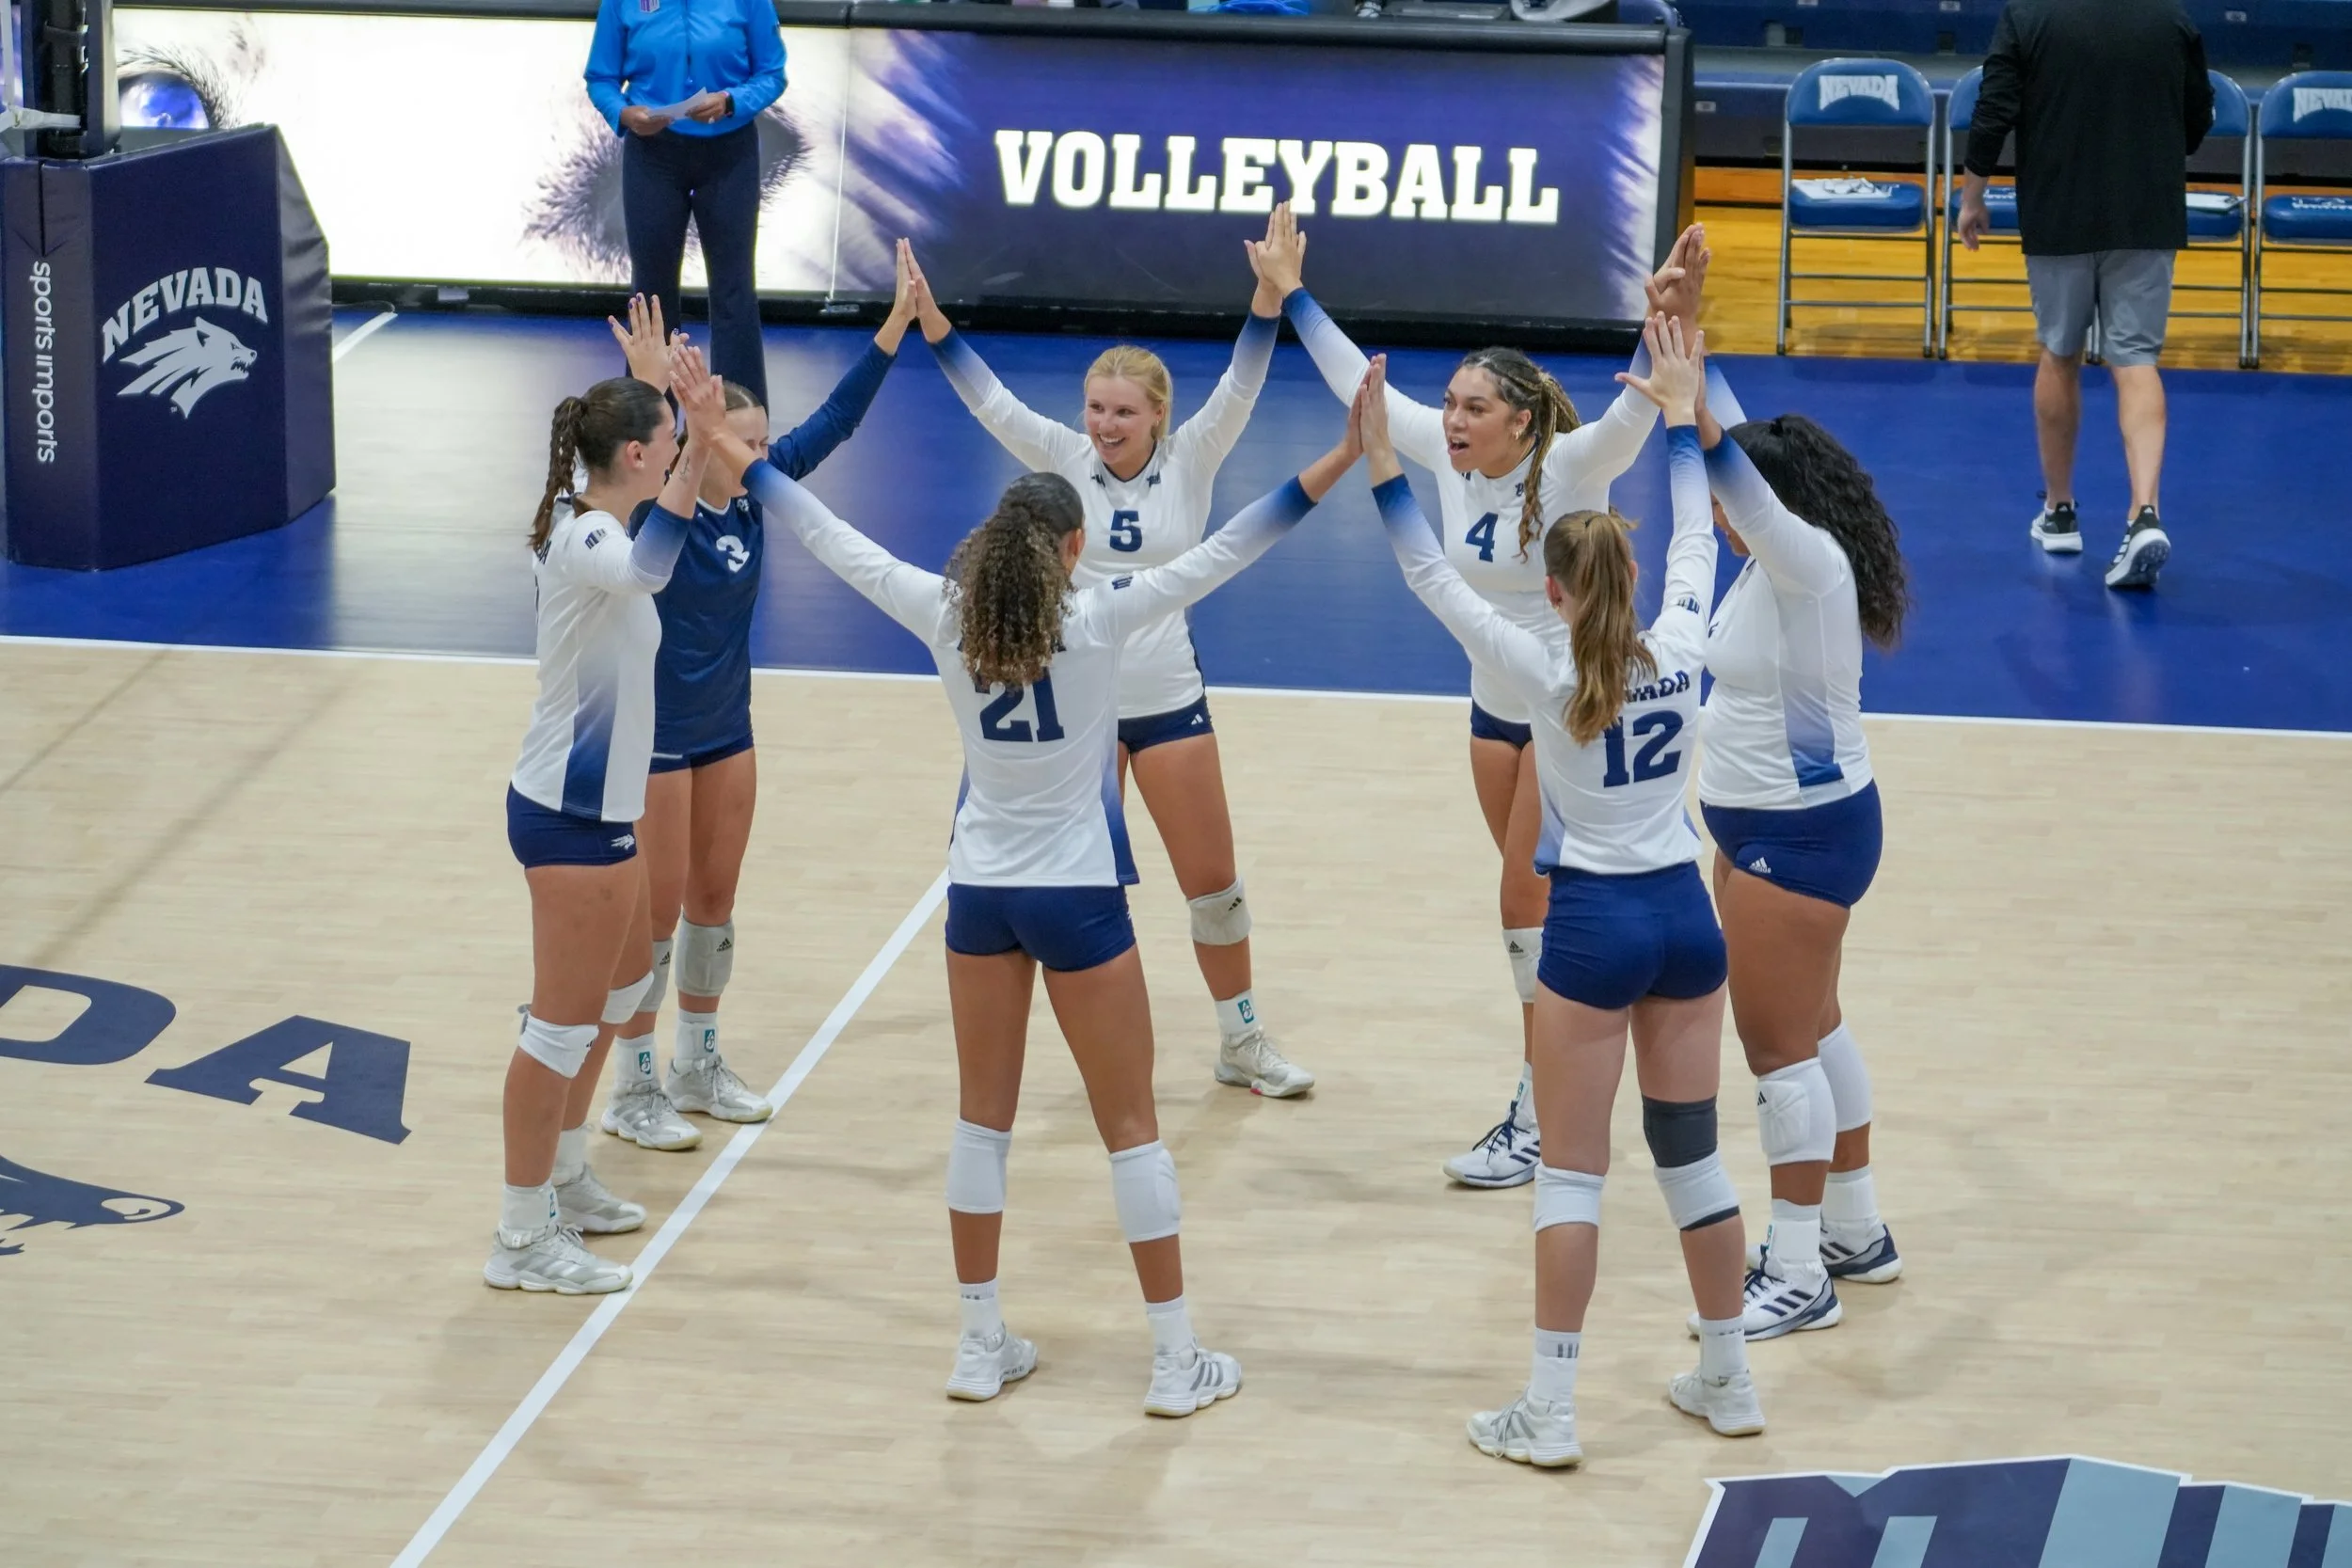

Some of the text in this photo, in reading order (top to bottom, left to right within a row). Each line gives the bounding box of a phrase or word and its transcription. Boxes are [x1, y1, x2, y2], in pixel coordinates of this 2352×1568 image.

[1819, 75, 1899, 111] NEVADA
[994, 129, 1561, 224] VOLLEYBALL
[101, 266, 268, 364] NEVADA
[29, 260, 58, 464] sports imports
[716, 534, 750, 573] 3
[1109, 510, 1142, 552] 5
[1465, 511, 1499, 562] 4
[973, 666, 1065, 742] 21
[1603, 709, 1684, 788] 12
